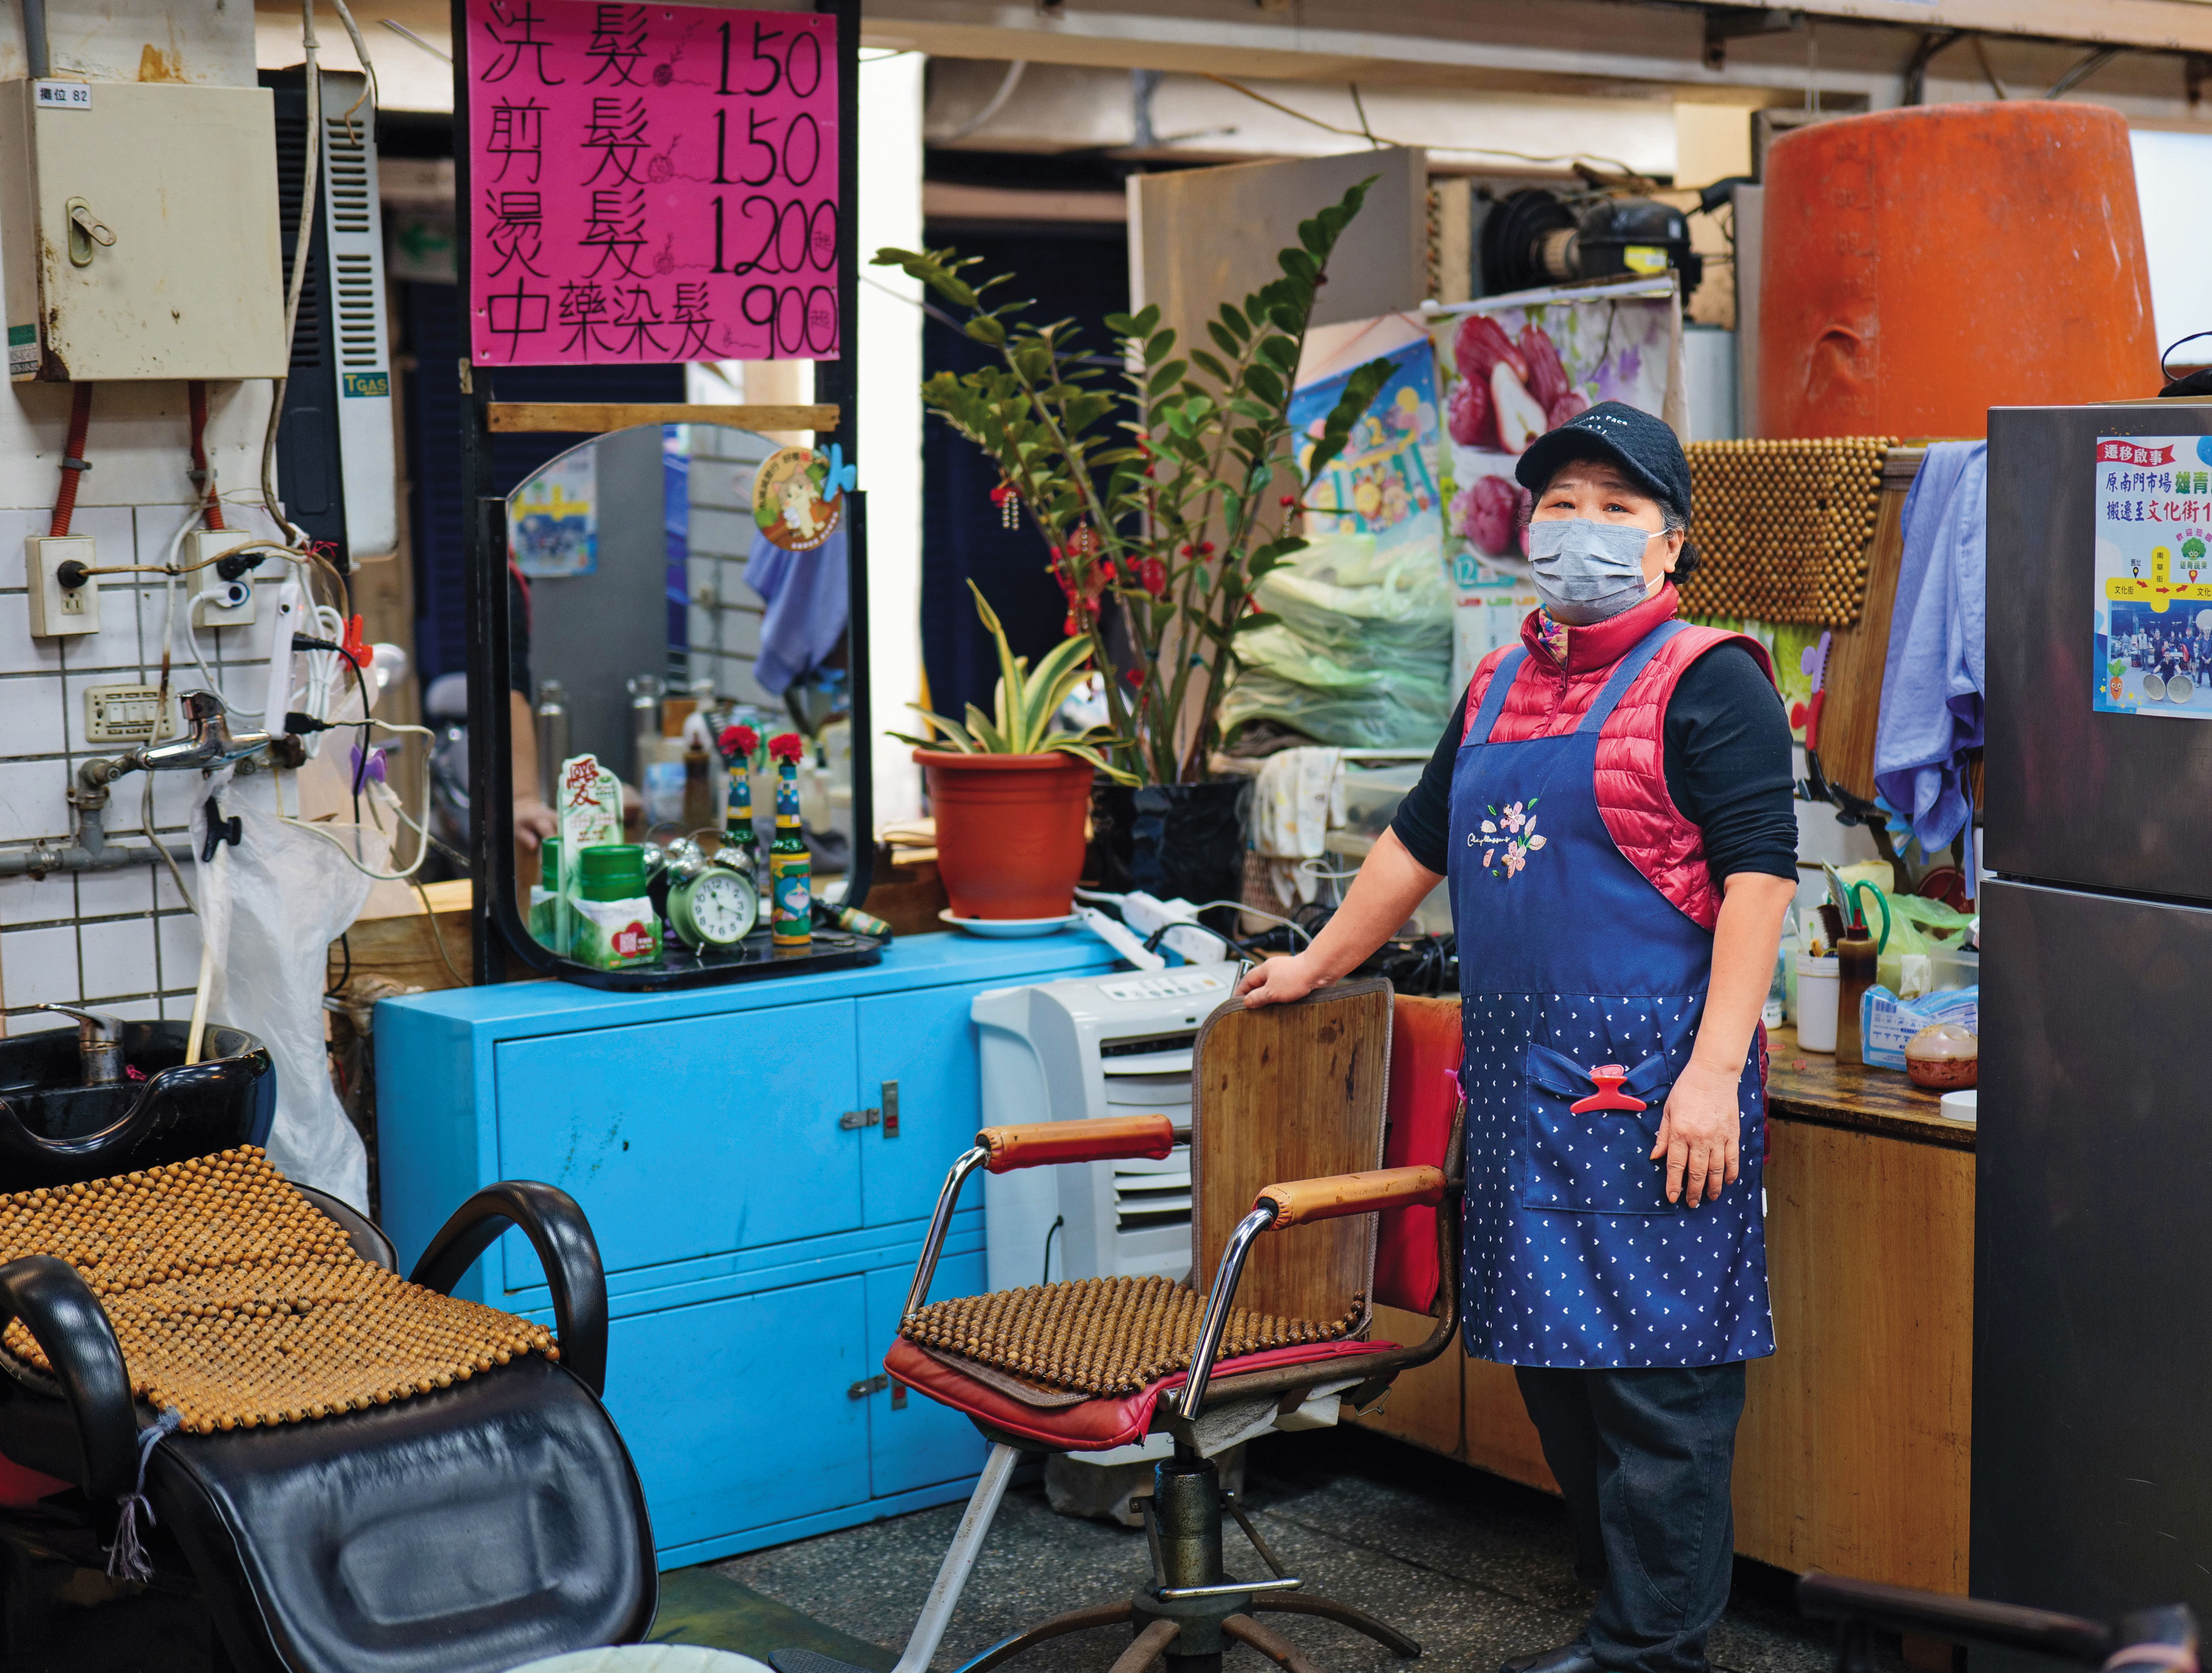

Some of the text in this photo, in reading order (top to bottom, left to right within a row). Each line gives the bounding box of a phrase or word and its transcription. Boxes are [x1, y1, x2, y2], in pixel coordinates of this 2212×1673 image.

[714, 21, 821, 98] 150
[40, 87, 87, 102] 攤位 82
[710, 108, 820, 187] 150
[709, 195, 839, 276] 1200
[487, 277, 732, 362] 中藥染髮
[741, 285, 838, 361] 900
[1606, 415, 1628, 426] Face
[2104, 444, 2163, 465] 遷移啟事
[2114, 585, 2134, 595] 文化街
[2197, 587, 2212, 597] 文化
[712, 879, 722, 889] 12
[734, 888, 740, 898] 2
[719, 926, 726, 936] 6
